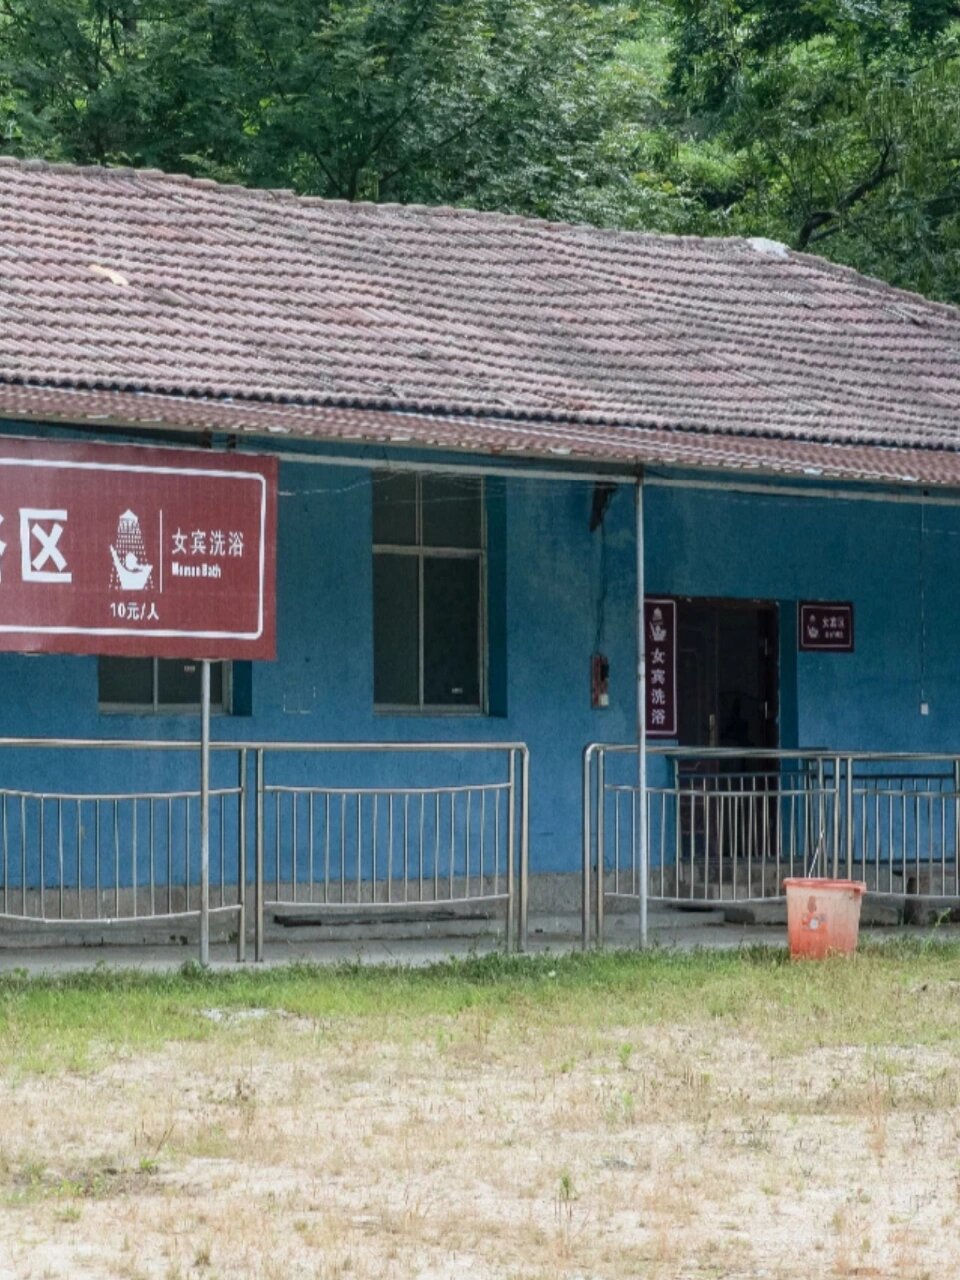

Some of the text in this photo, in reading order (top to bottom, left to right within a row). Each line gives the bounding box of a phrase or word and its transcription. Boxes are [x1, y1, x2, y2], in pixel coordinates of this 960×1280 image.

[171, 527, 244, 557] 女宾洗浴
[110, 602, 159, 621] 10元/人
[651, 648, 665, 725] 女宾洗浴
